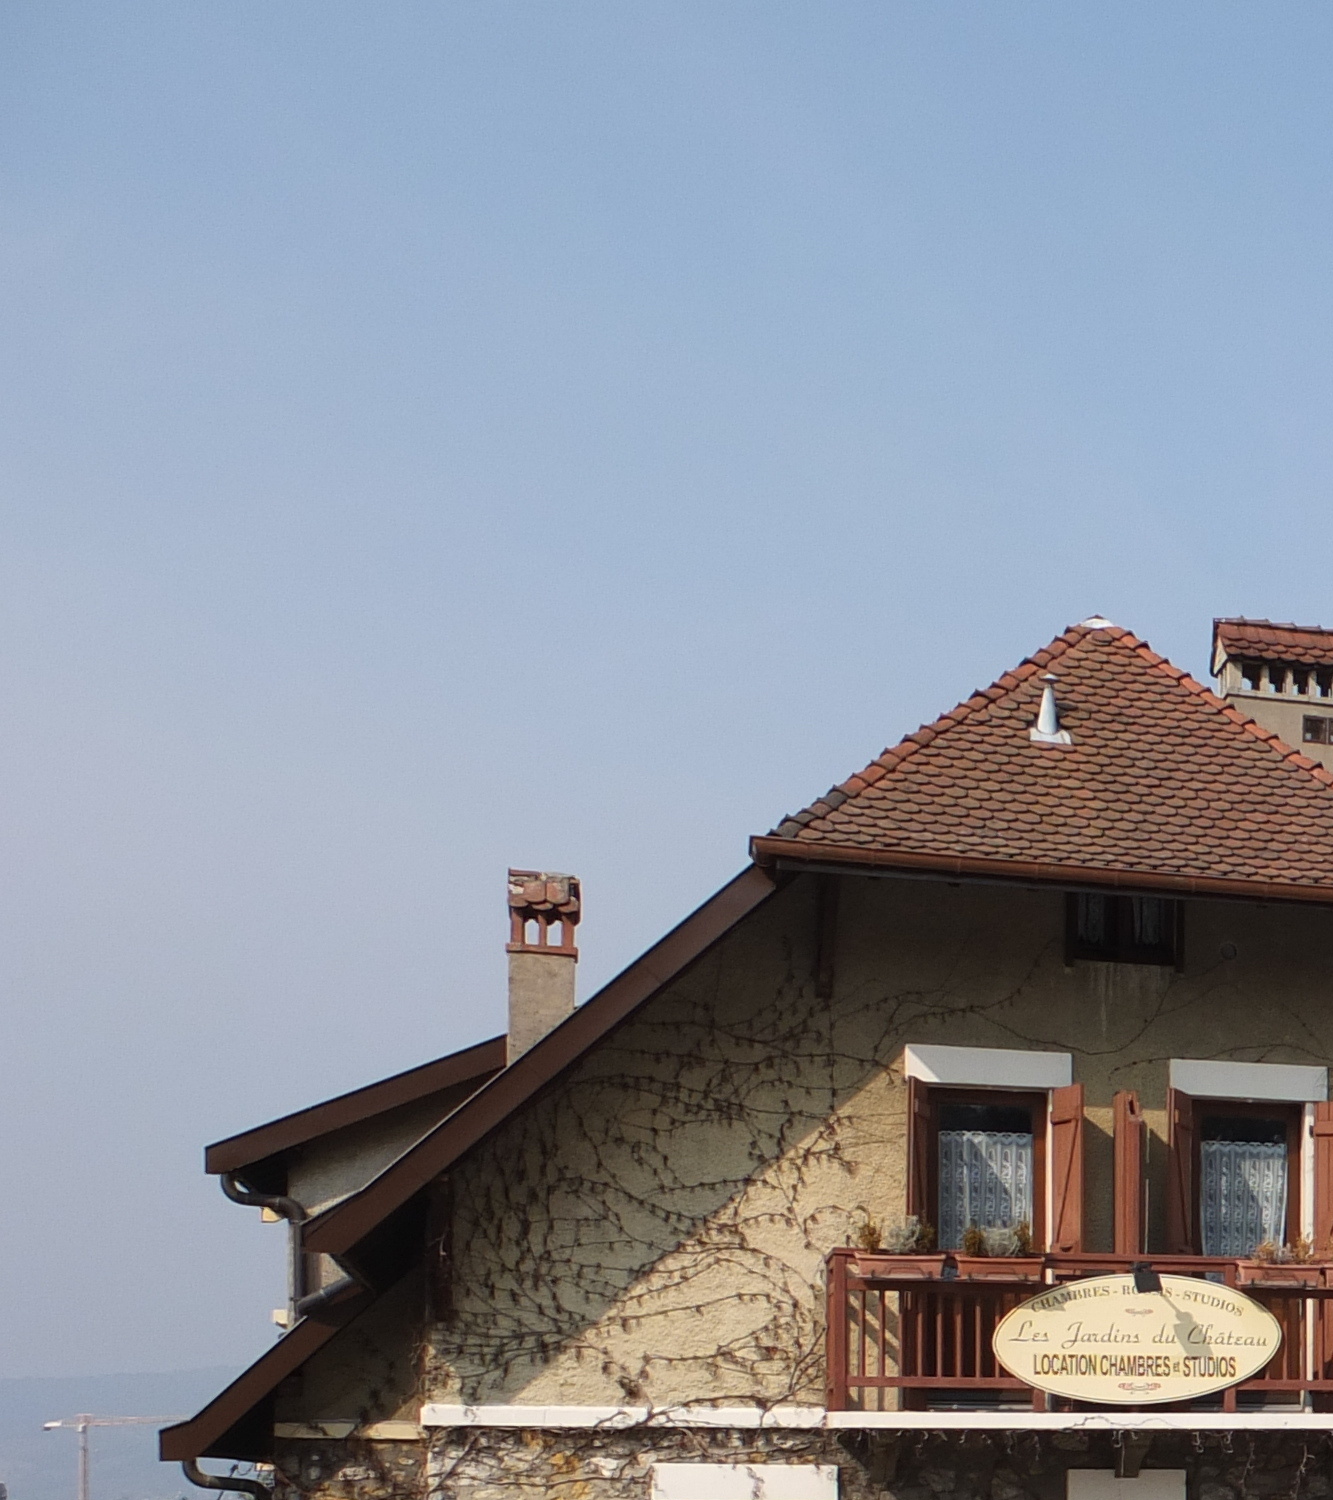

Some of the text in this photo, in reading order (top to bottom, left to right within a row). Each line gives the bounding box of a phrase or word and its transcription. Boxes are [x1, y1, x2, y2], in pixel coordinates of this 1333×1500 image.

[1031, 1285, 1110, 1312] CHAMBRES
[1182, 1290, 1245, 1317] STUDIOS
[1008, 1320, 1268, 1349] Les Jardins du Château
[1033, 1353, 1098, 1376] LOCATION
[1100, 1354, 1171, 1377] CHAMBRES
[1183, 1356, 1237, 1377] STUDIOS
